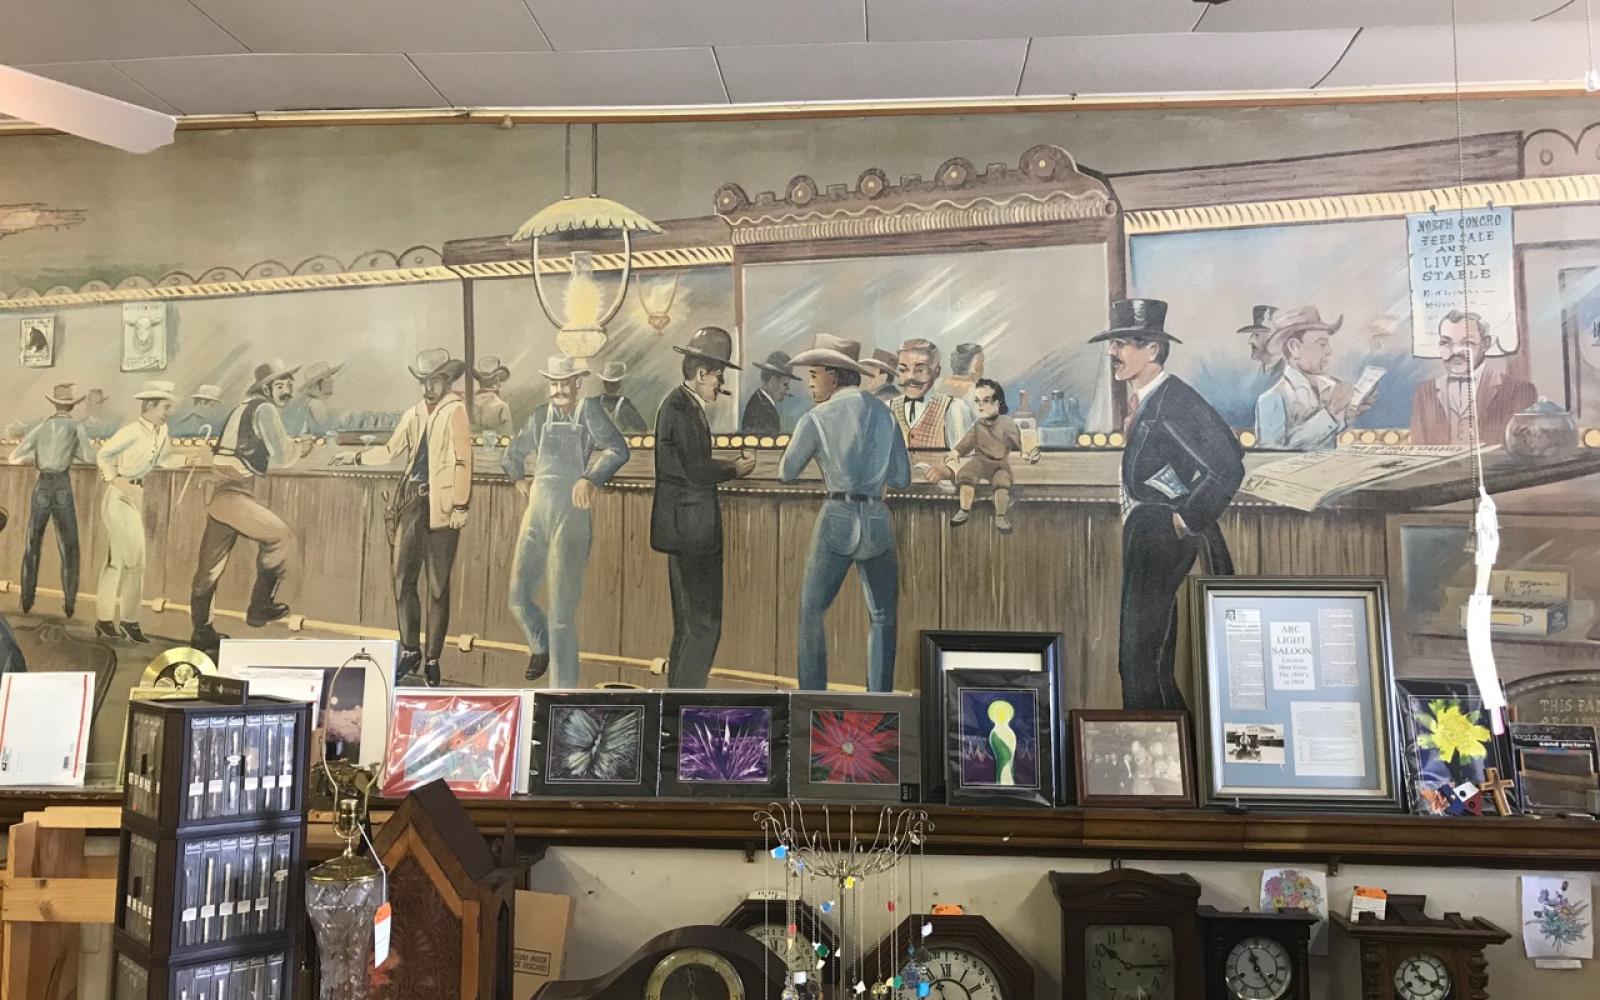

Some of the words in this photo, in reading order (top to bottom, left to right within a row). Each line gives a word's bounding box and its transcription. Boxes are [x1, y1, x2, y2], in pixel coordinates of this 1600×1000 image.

[1423, 253, 1490, 268] LIVERY
[1422, 269, 1491, 281] STABLE
[1280, 625, 1300, 633] ARC
[1276, 636, 1305, 644] LIGHT
[1271, 648, 1312, 656] SALOON
[1539, 699, 1573, 712] THIS
